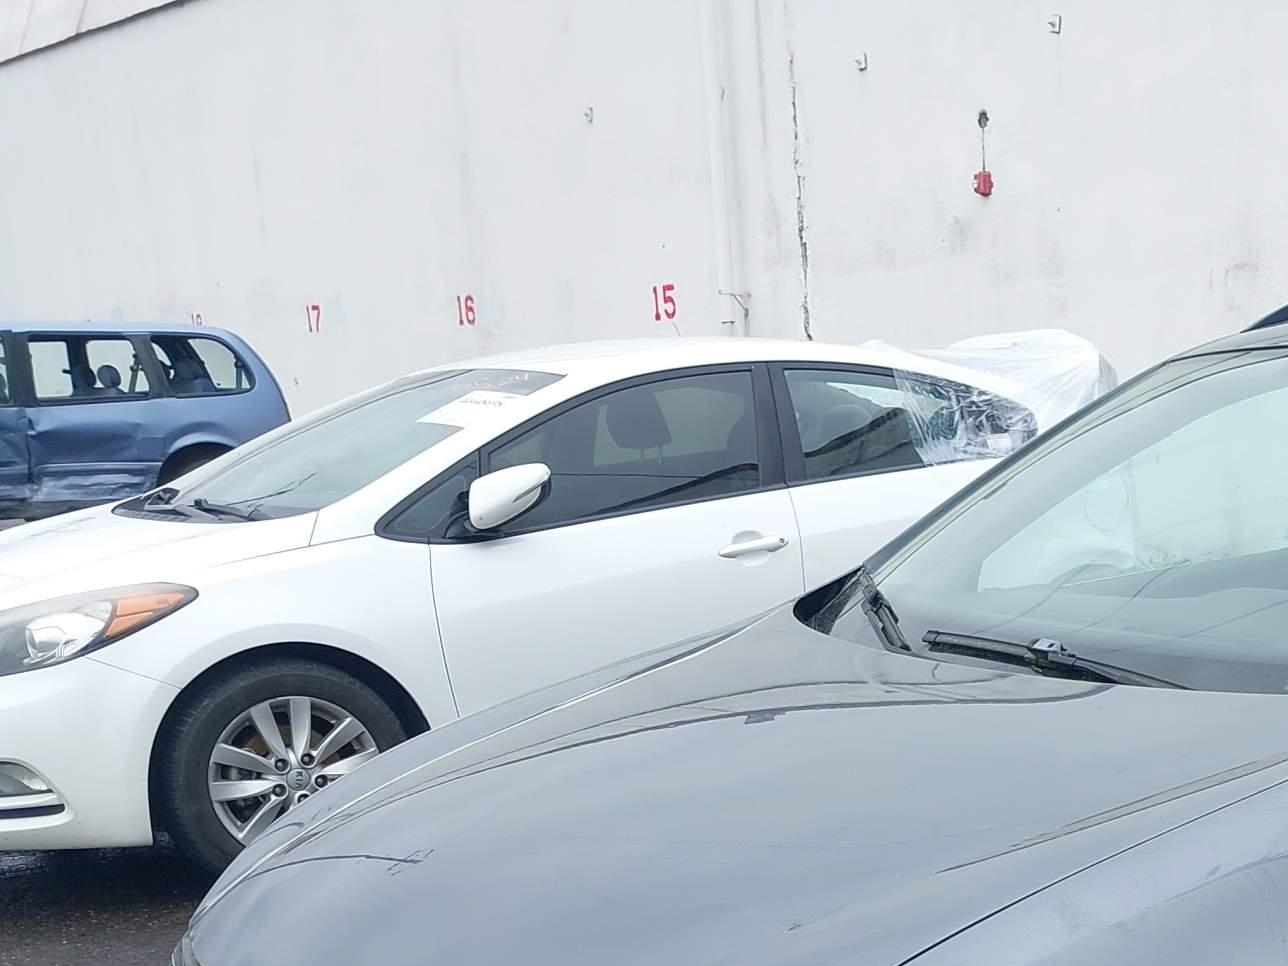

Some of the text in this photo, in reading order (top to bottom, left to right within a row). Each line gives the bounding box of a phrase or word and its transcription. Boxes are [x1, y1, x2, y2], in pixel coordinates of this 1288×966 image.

[305, 304, 321, 332] 17
[457, 295, 477, 326] 16
[653, 284, 677, 321] 15
